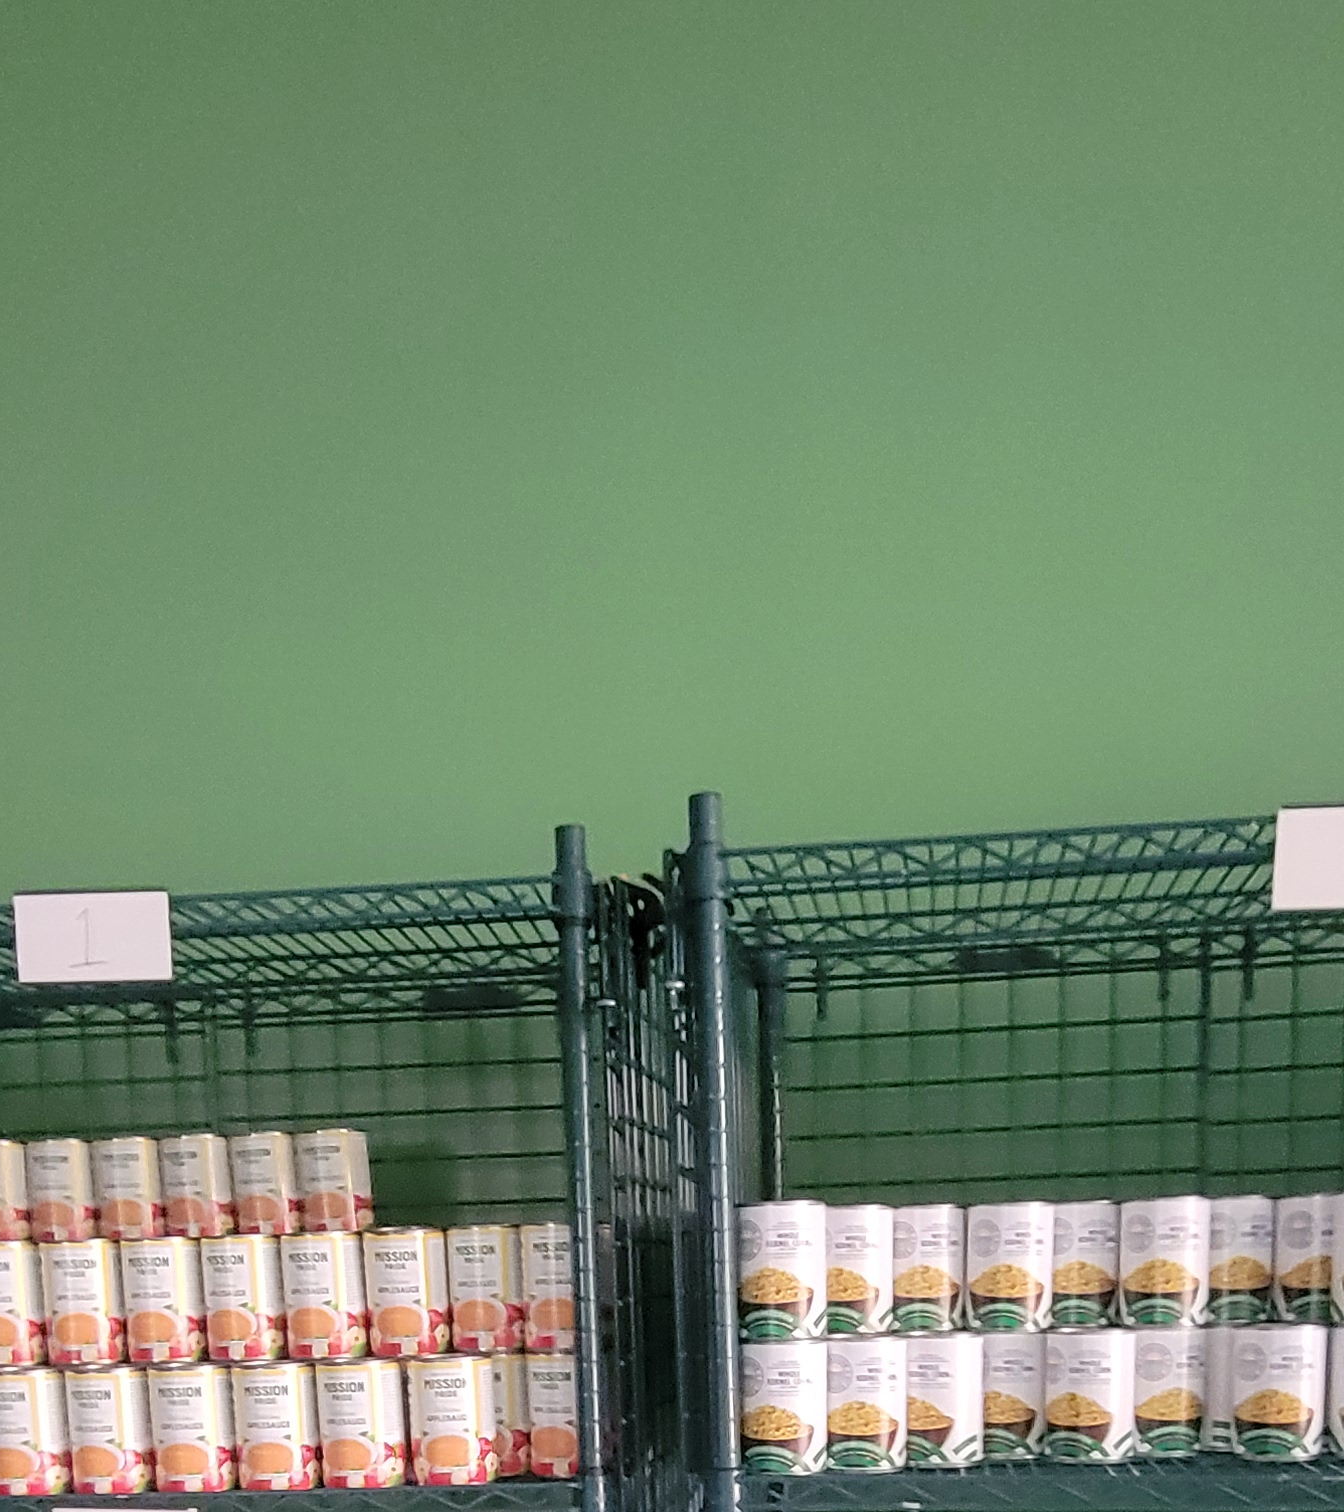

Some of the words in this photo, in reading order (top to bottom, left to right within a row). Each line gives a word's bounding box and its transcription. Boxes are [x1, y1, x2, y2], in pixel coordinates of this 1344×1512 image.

[69, 907, 108, 968] 1
[374, 1250, 418, 1263] MISSION
[158, 1386, 202, 1398] MISSION
[244, 1385, 289, 1397] MISSION
